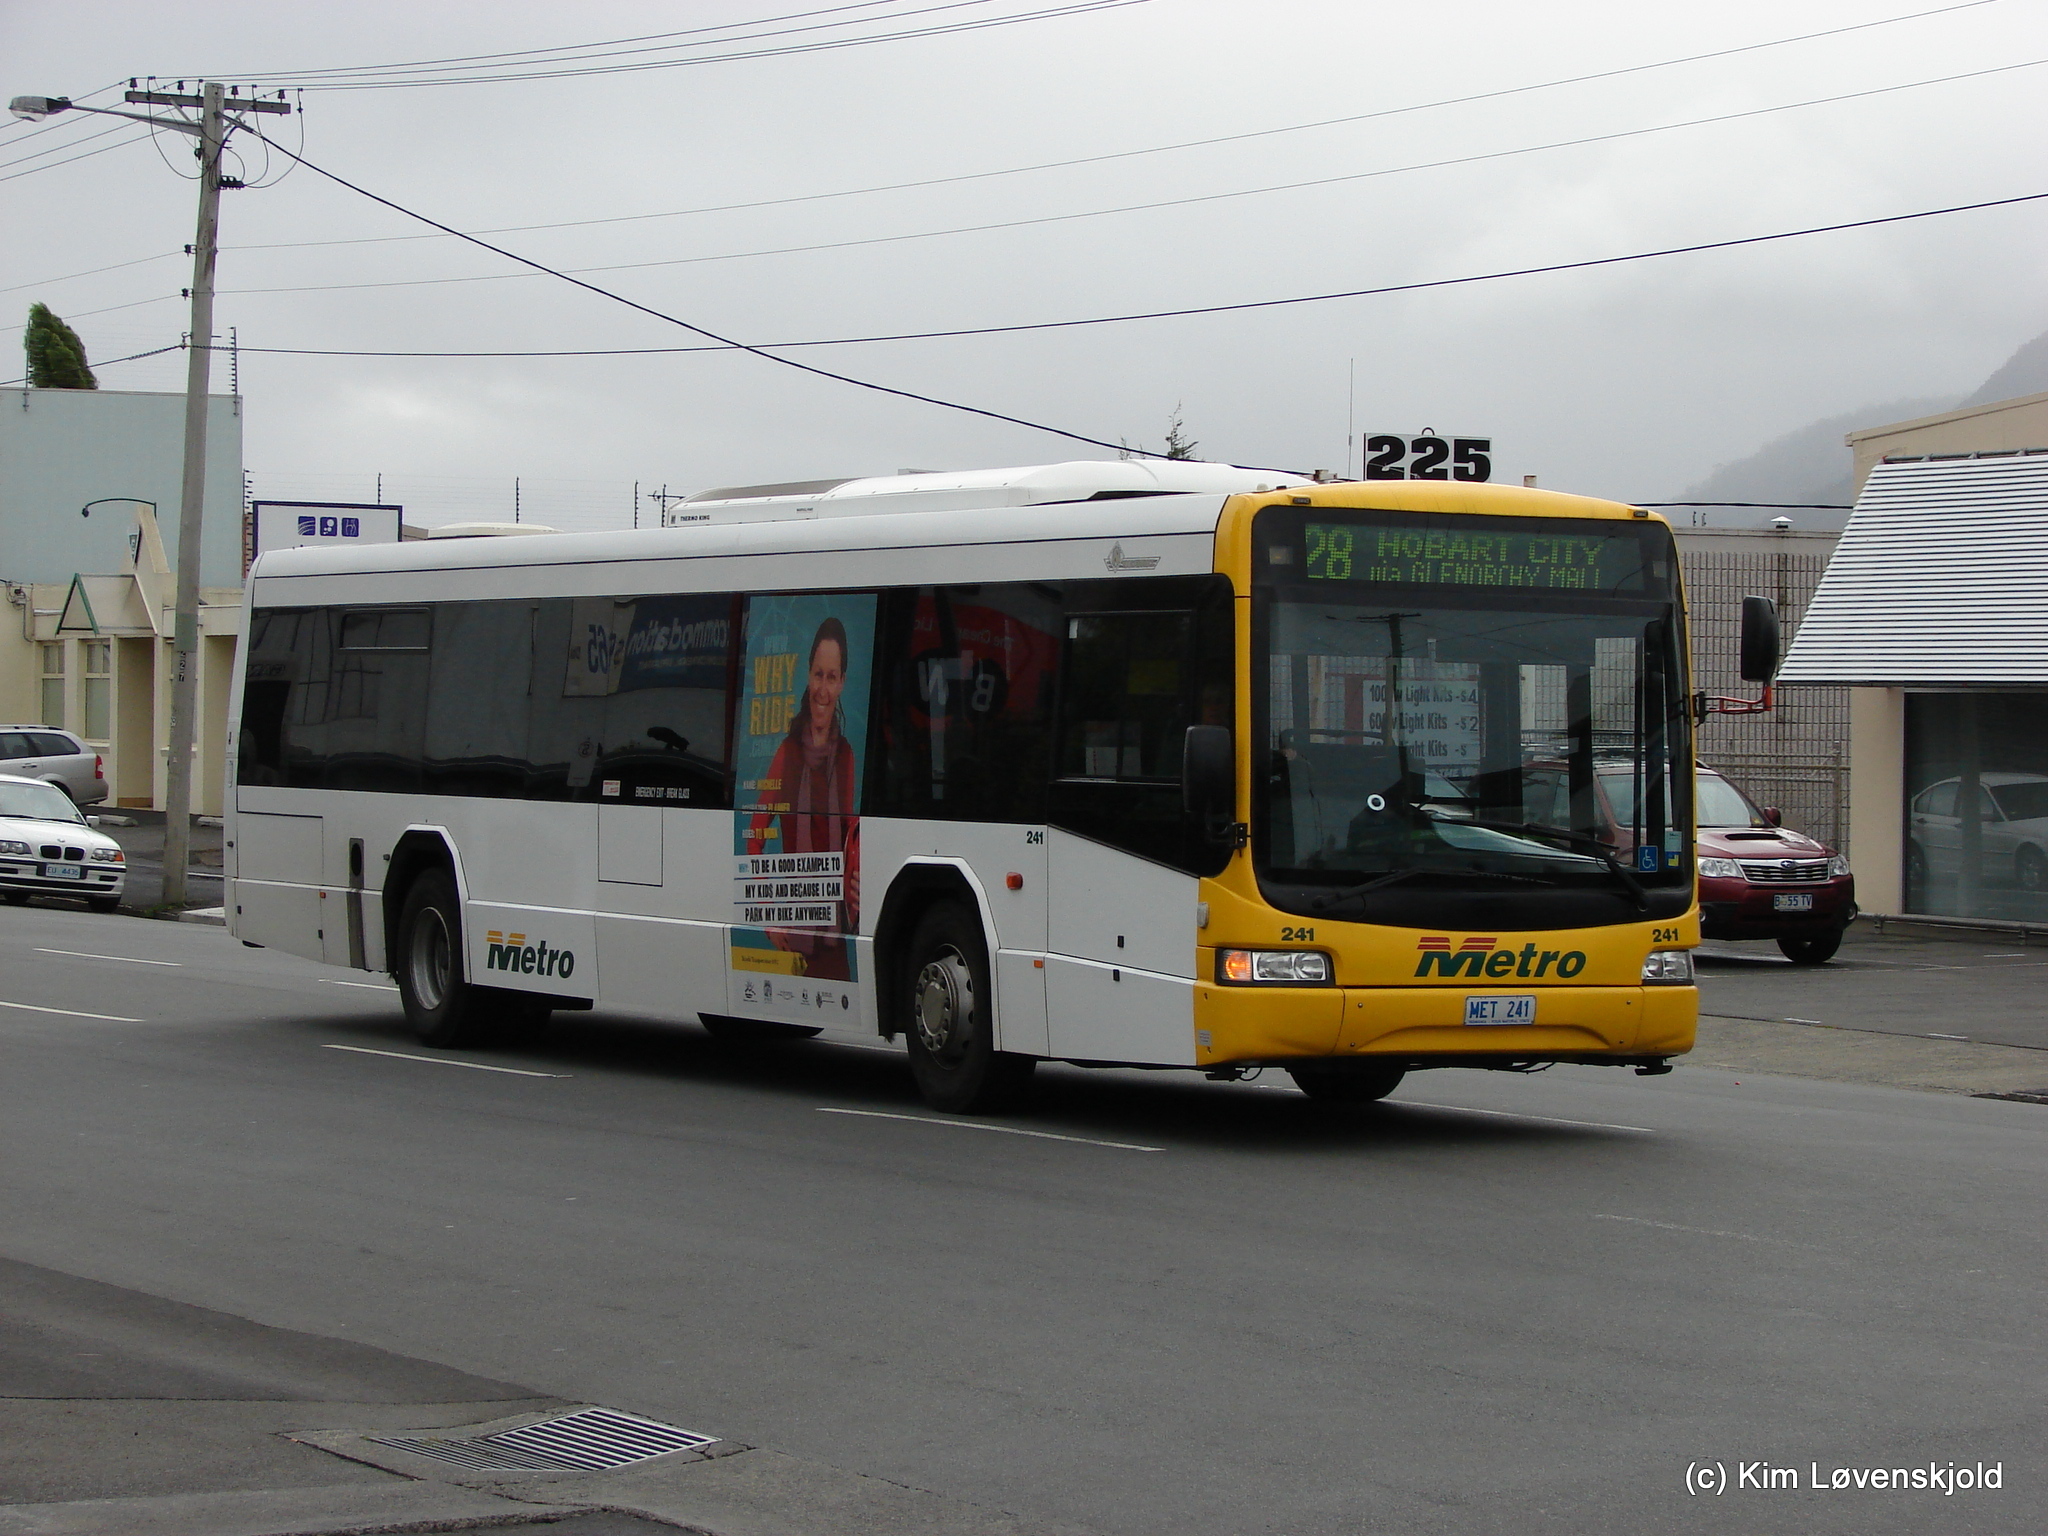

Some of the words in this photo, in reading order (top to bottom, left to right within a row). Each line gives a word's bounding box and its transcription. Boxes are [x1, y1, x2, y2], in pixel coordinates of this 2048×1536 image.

[1366, 435, 1491, 483] 225
[1305, 525, 1353, 579] 28
[1378, 531, 1513, 562] HOBART
[1529, 537, 1604, 565] CITY
[755, 653, 798, 695] WHY
[1406, 685, 1431, 706] Light
[750, 694, 795, 736] RIDE
[1400, 712, 1425, 733] Light
[1427, 712, 1448, 729] Kits
[1427, 739, 1448, 757] Kits
[1027, 831, 1044, 845] 241
[751, 859, 760, 875] TO
[761, 859, 770, 873] BE
[772, 859, 777, 873] A
[778, 858, 796, 873] GOOD
[797, 857, 830, 873] EXAMPLE
[831, 857, 841, 872] TO
[745, 884, 756, 899] MY
[757, 883, 773, 899] KIDS
[775, 883, 788, 898] AND
[790, 882, 820, 898] BECAUSE
[821, 882, 825, 897] I
[826, 882, 841, 897] CAN
[745, 907, 763, 922] PARK
[765, 907, 776, 921] MY
[777, 907, 793, 921] BIKE
[794, 906, 832, 921] ANYWHERE
[1281, 926, 1315, 942] 241
[1652, 928, 1679, 943] 241
[486, 930, 575, 978] Metro
[1414, 937, 1587, 979] Metro
[1469, 1000, 1498, 1019] MET
[1507, 1000, 1530, 1018] 241
